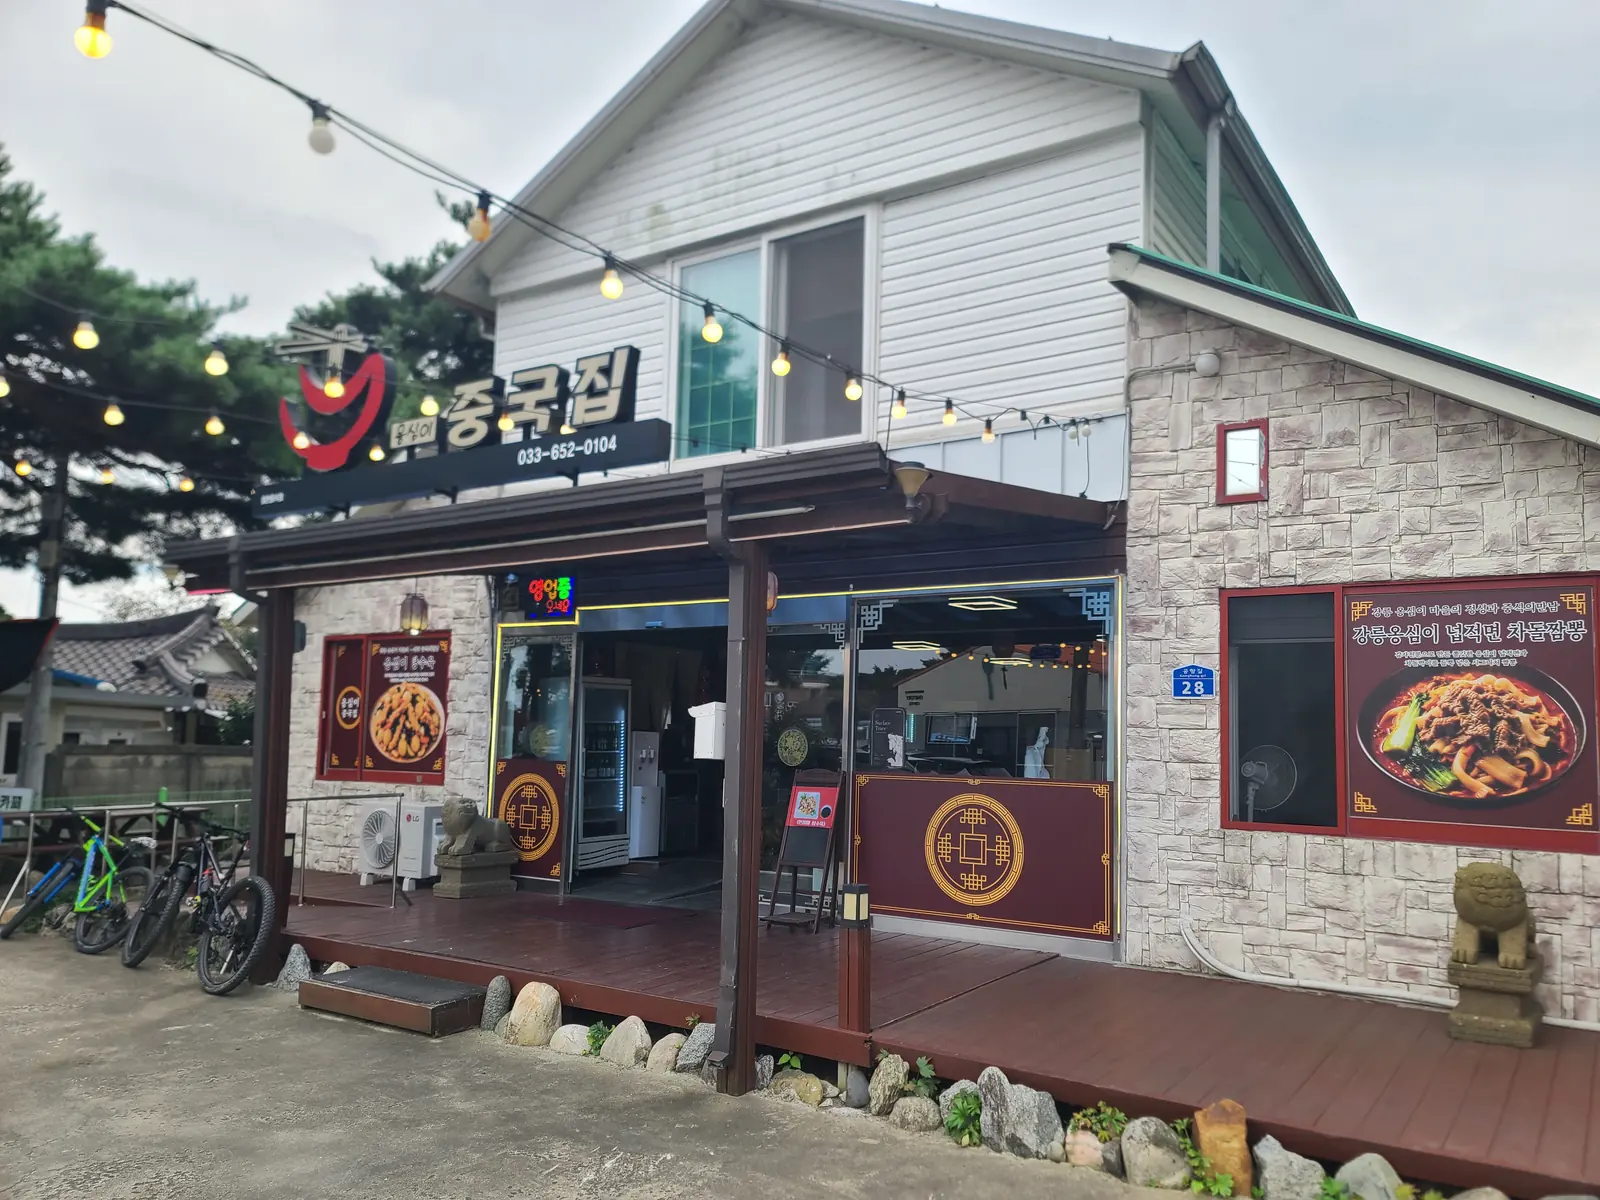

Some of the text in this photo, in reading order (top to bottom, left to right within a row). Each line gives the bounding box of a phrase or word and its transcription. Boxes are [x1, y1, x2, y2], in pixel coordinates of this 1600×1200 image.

[447, 344, 632, 448] 중국집
[395, 421, 434, 446] 옹심이
[517, 434, 617, 465] 033-652-0104
[529, 577, 571, 601] 영업중
[1371, 607, 1393, 618] 강릉
[1395, 605, 1427, 617] 옹심이
[1429, 604, 1462, 616] 마을의
[1464, 603, 1500, 615] 정성과
[1352, 620, 1587, 645] 강릉옹심이 넙적면 차돌짬뽕
[1182, 681, 1204, 694] 28
